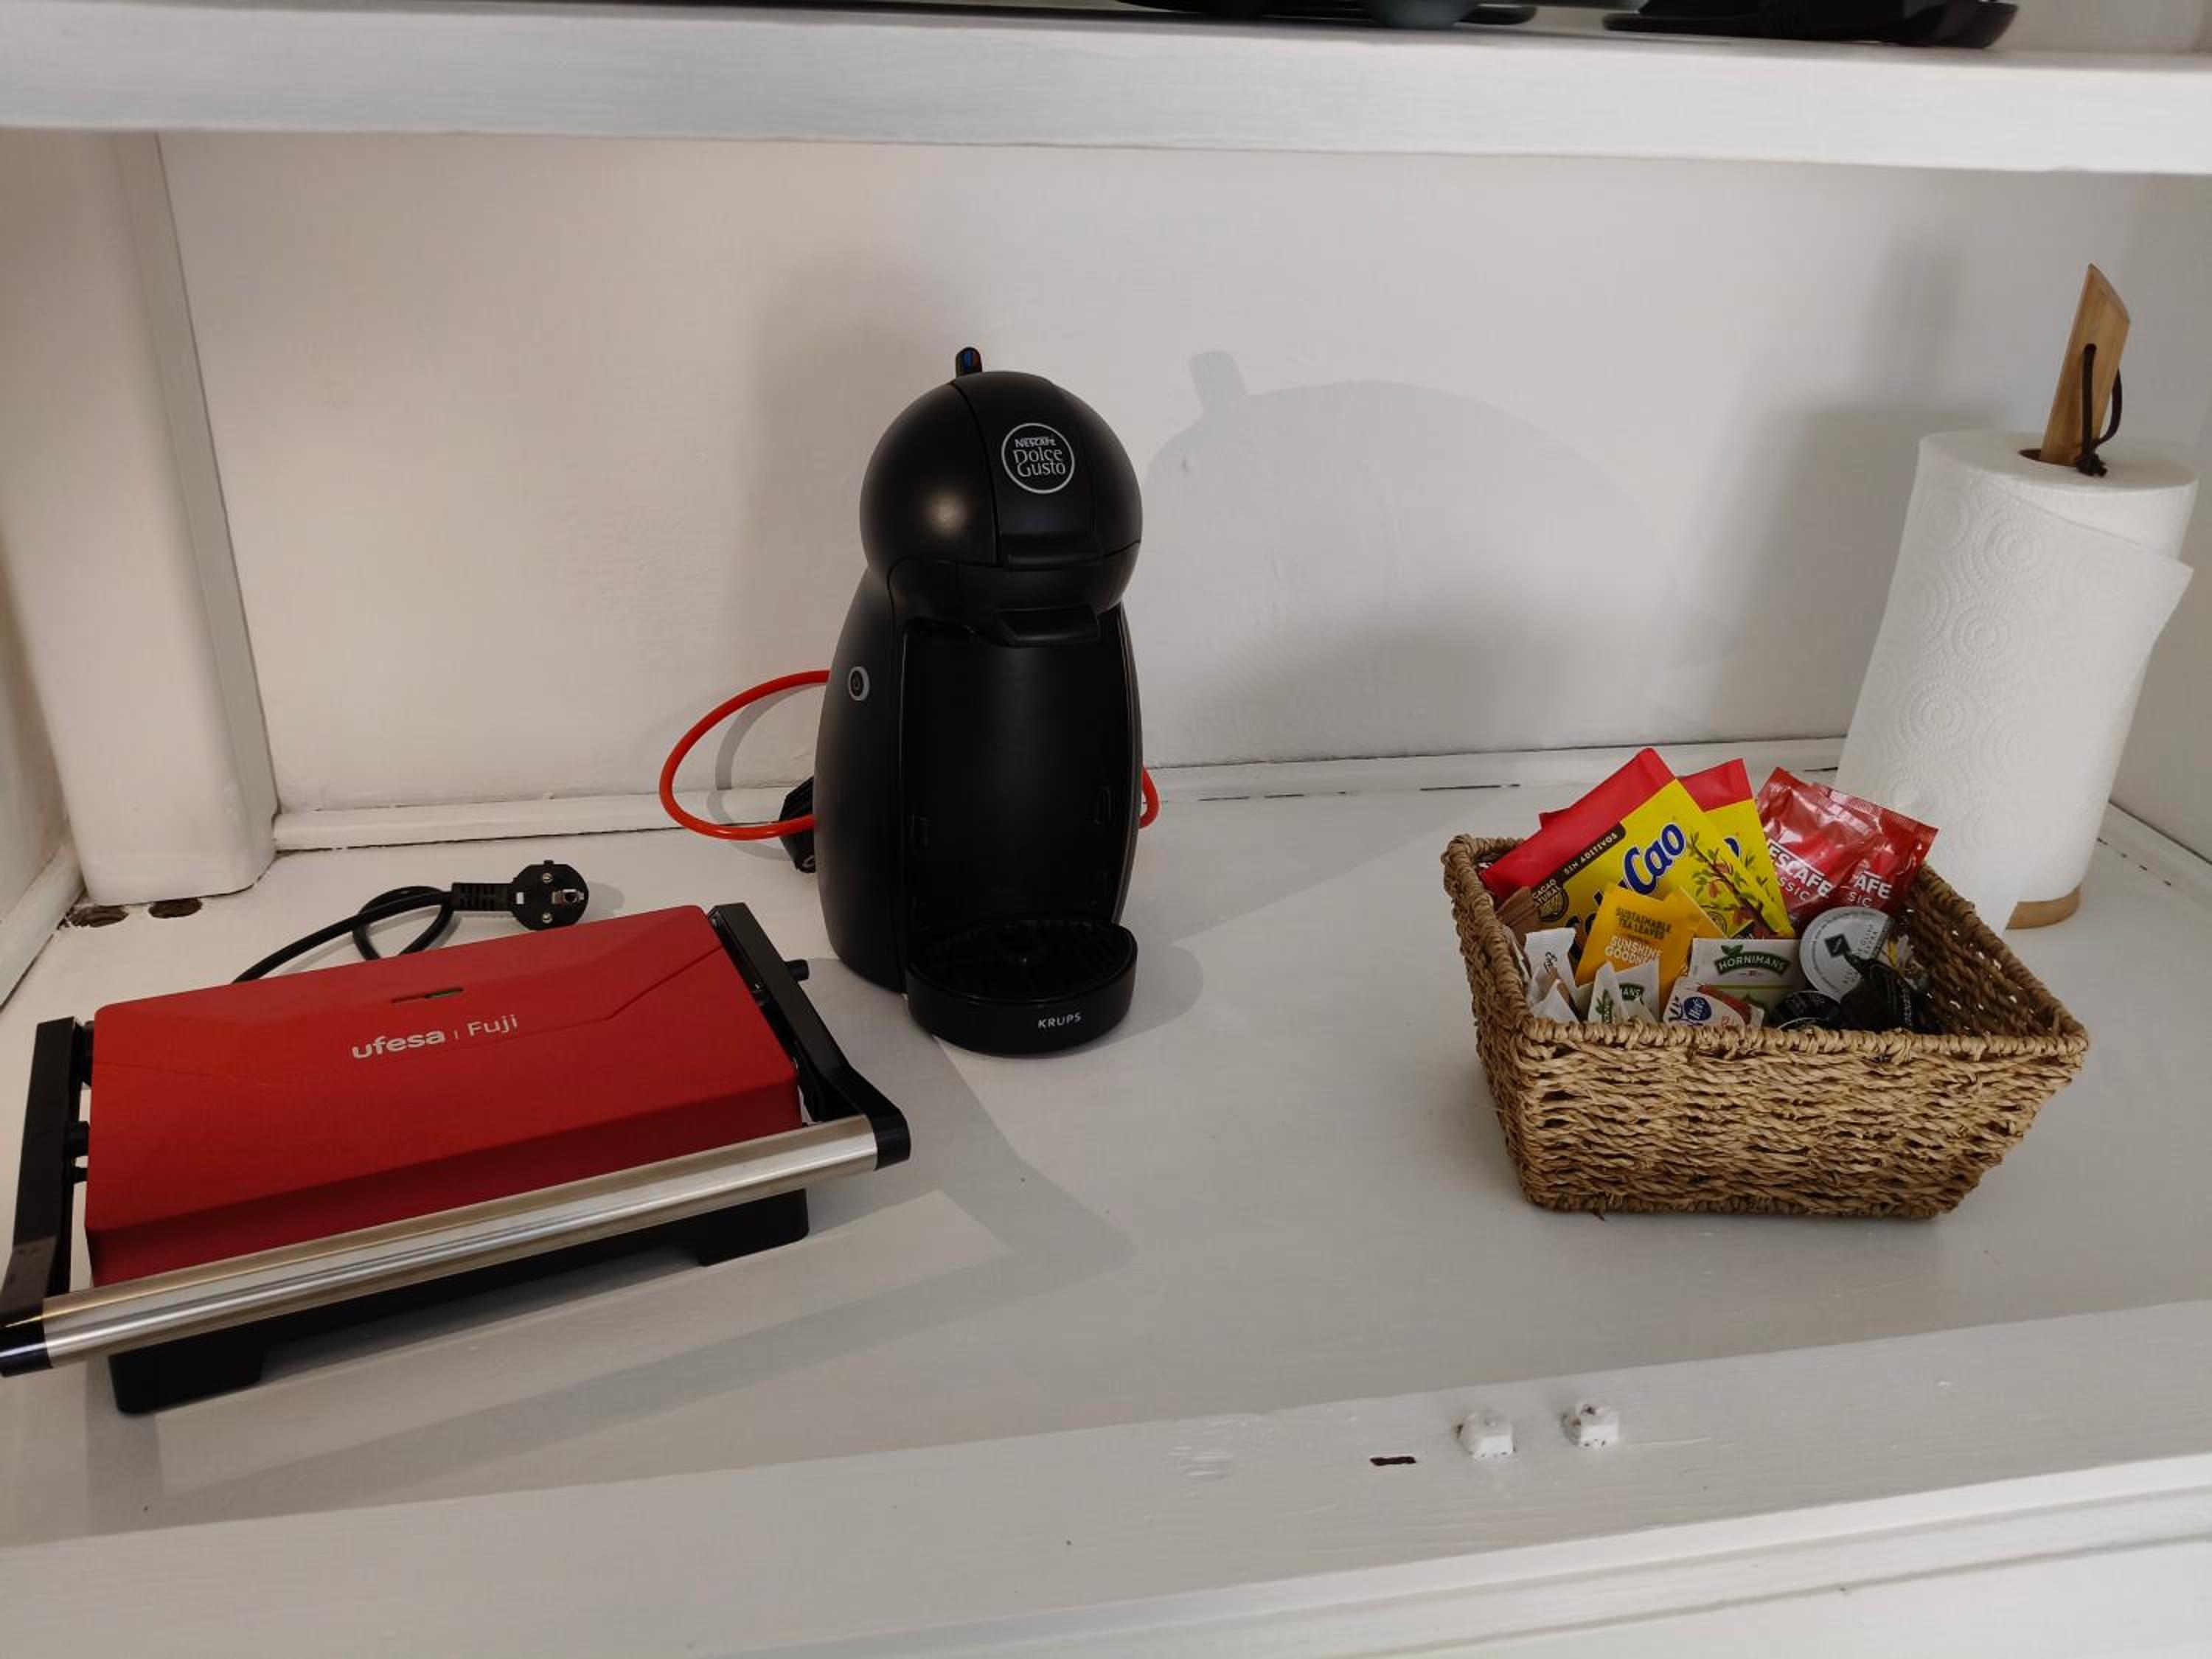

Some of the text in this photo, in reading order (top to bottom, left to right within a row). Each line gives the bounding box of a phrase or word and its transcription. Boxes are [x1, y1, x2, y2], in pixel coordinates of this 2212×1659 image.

[1013, 447, 1062, 464] Dolce
[1017, 459, 1065, 477] Gusto
[1564, 832, 1618, 874] SIN ADITIVOS
[1624, 822, 1686, 895] Cao
[1769, 842, 1834, 897] ESCAFE
[1534, 885, 1563, 908] ATURAL
[1778, 877, 1811, 900] SSIC
[1610, 935, 1663, 957] SUNSHINE
[1719, 954, 1786, 971] HORNIMANS
[1037, 1012, 1082, 1029] KRUPS
[352, 1014, 518, 1058] ufesa Fuji
